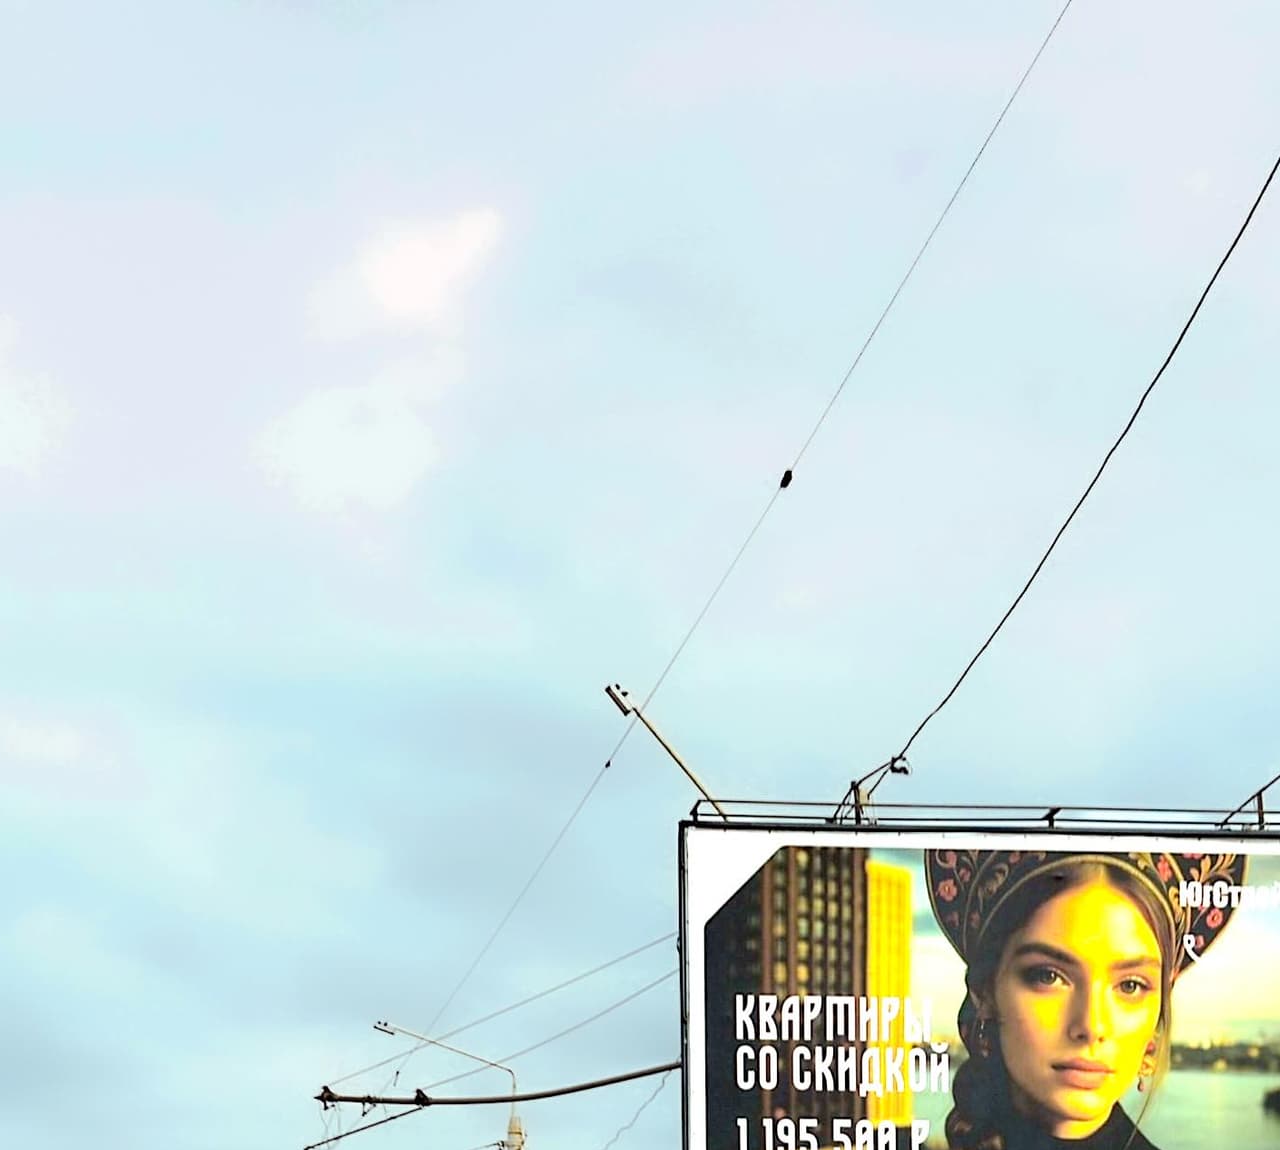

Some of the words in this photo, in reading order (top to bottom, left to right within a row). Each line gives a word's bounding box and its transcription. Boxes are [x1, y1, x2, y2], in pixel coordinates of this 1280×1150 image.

[735, 994, 933, 1042] КВАРТИРЫ
[736, 1045, 778, 1091] СО
[792, 1041, 950, 1097] СКИДКОЙ
